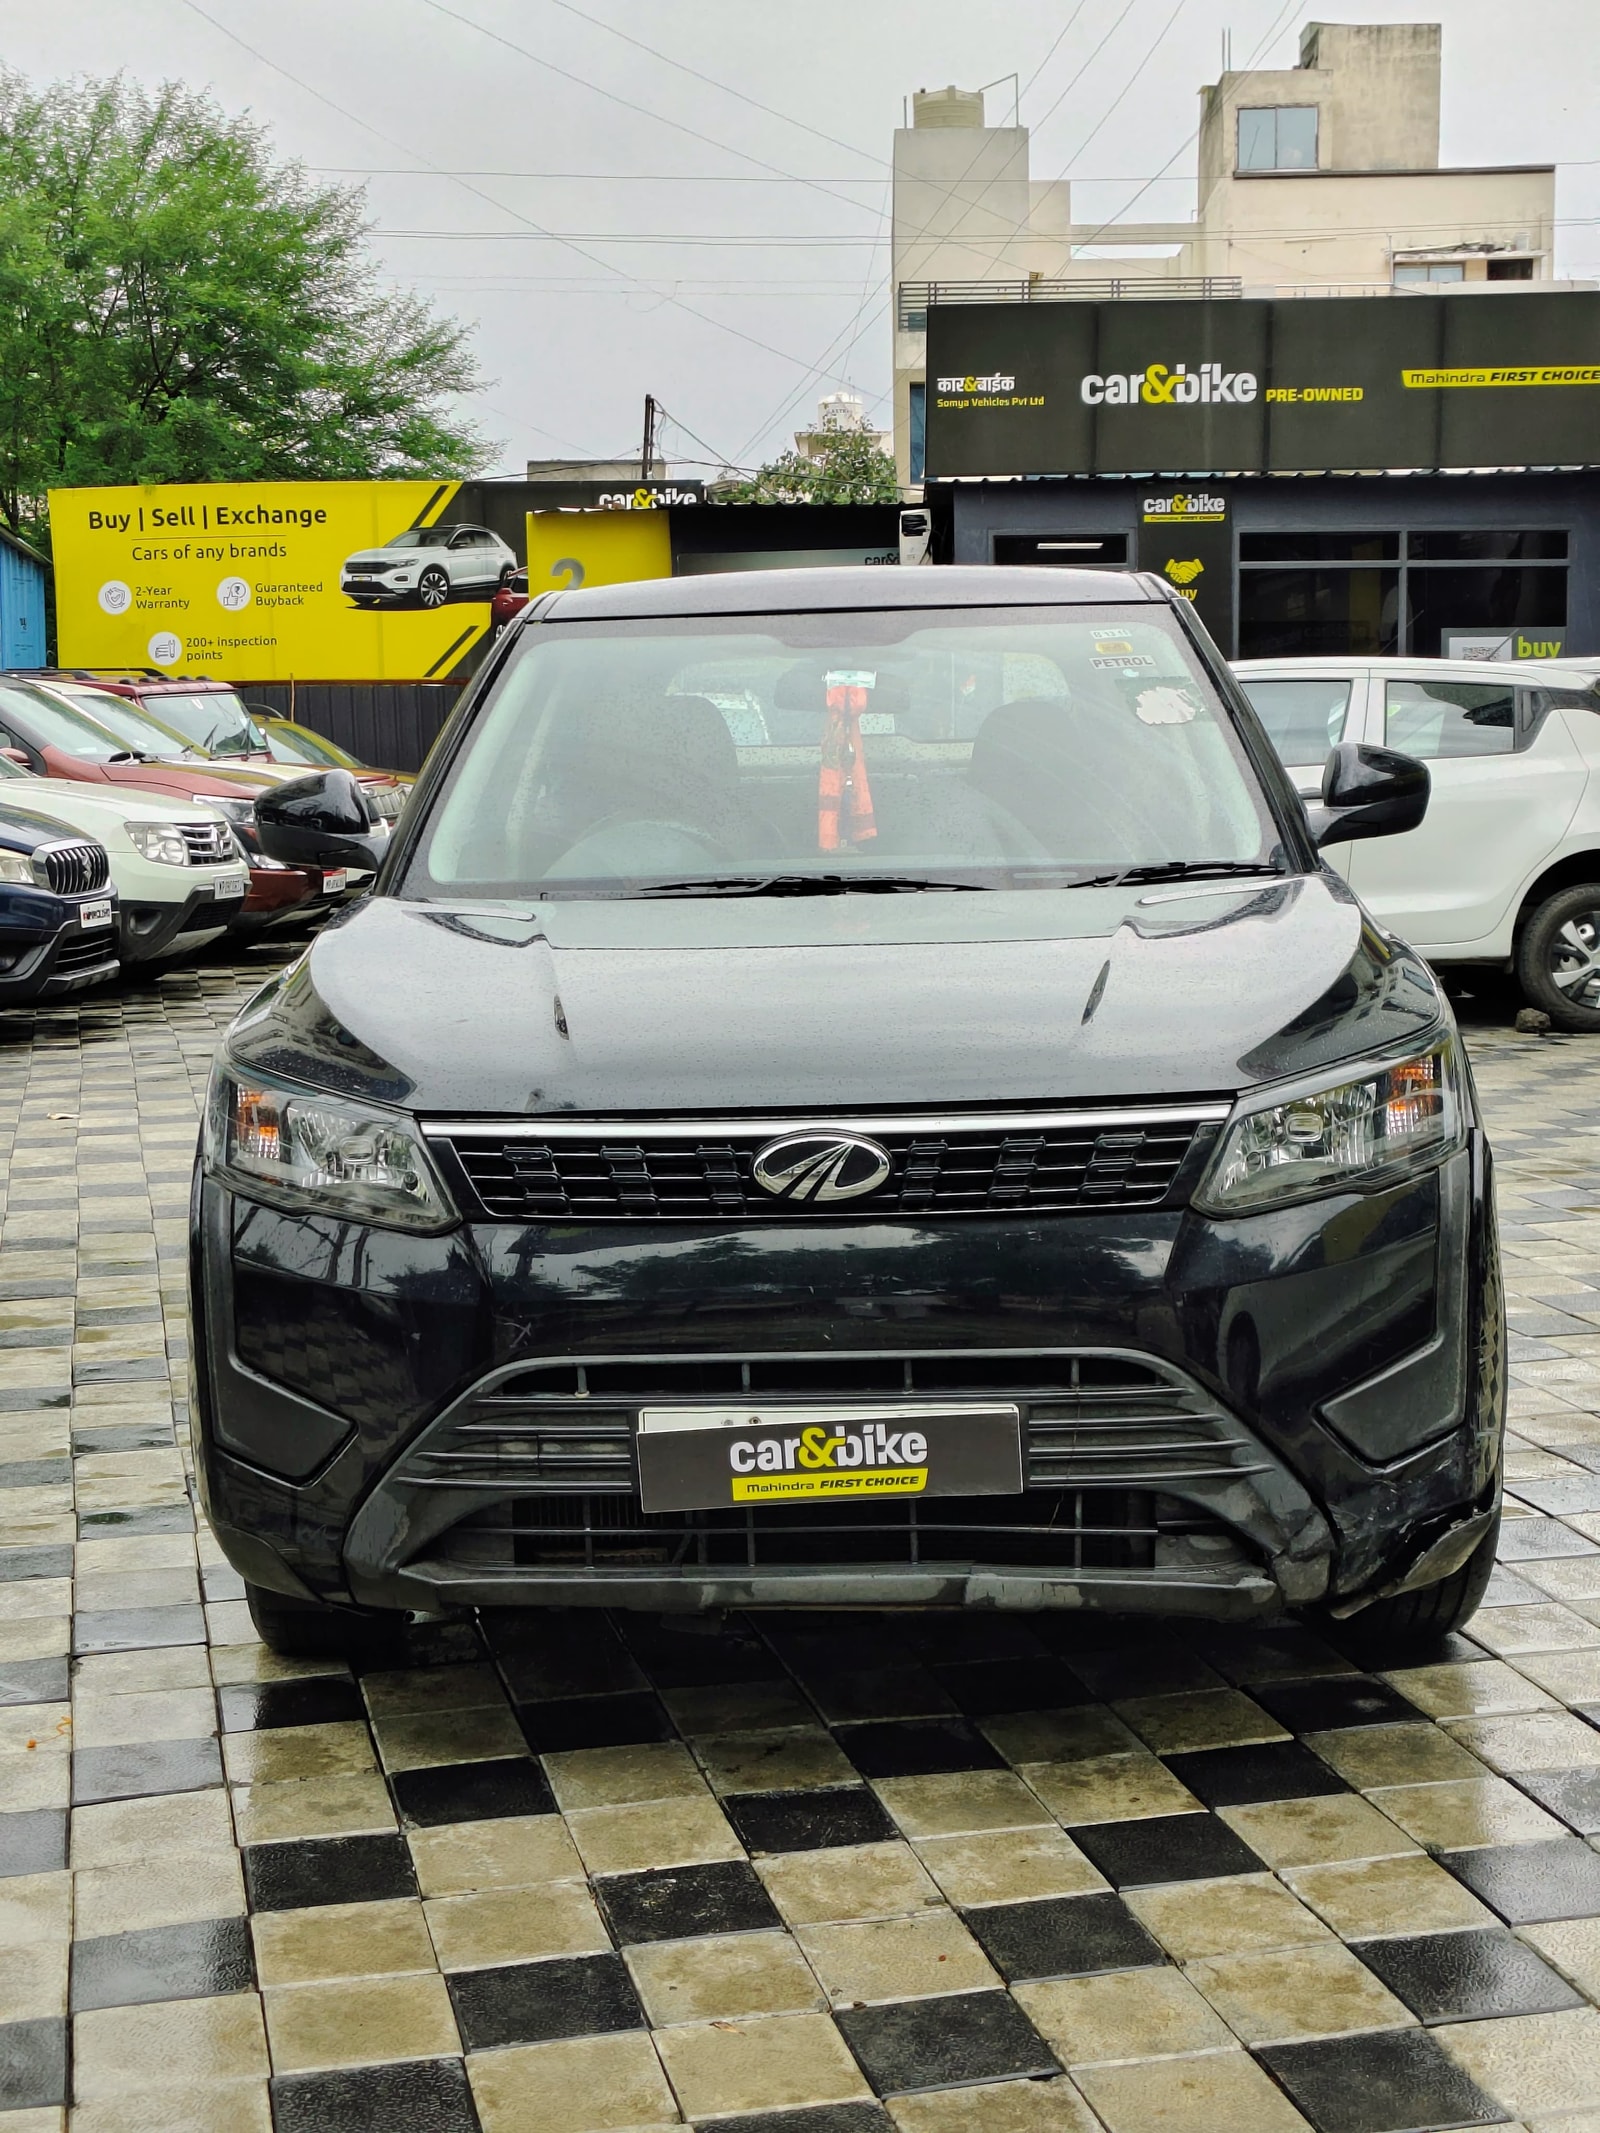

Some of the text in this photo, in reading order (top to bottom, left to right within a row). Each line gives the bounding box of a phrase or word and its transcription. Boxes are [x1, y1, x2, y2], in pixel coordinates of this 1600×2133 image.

[1410, 370, 1600, 383] Mahindra FIRST CHOICE
[1081, 363, 1364, 404] car&bike PRE-OWNED
[937, 396, 1045, 409] Somya Vehicles Pvt Ltd
[1143, 494, 1225, 513] car&bike
[89, 511, 131, 532] Buy
[152, 506, 195, 527] Sell
[216, 504, 327, 527] Exchange
[132, 542, 287, 561] Cars of any brands
[136, 586, 172, 597] 2-Year
[255, 582, 323, 593] Guaranteed
[136, 598, 190, 610] Warranty
[255, 595, 305, 607] Buyback
[186, 636, 277, 649] 200+ inspection
[1517, 636, 1561, 659] buy
[186, 651, 223, 662] points
[1092, 656, 1153, 668] PETROL
[730, 1423, 928, 1473] car&bike
[747, 1476, 919, 1493] Mahindra FIRST CHOICE
